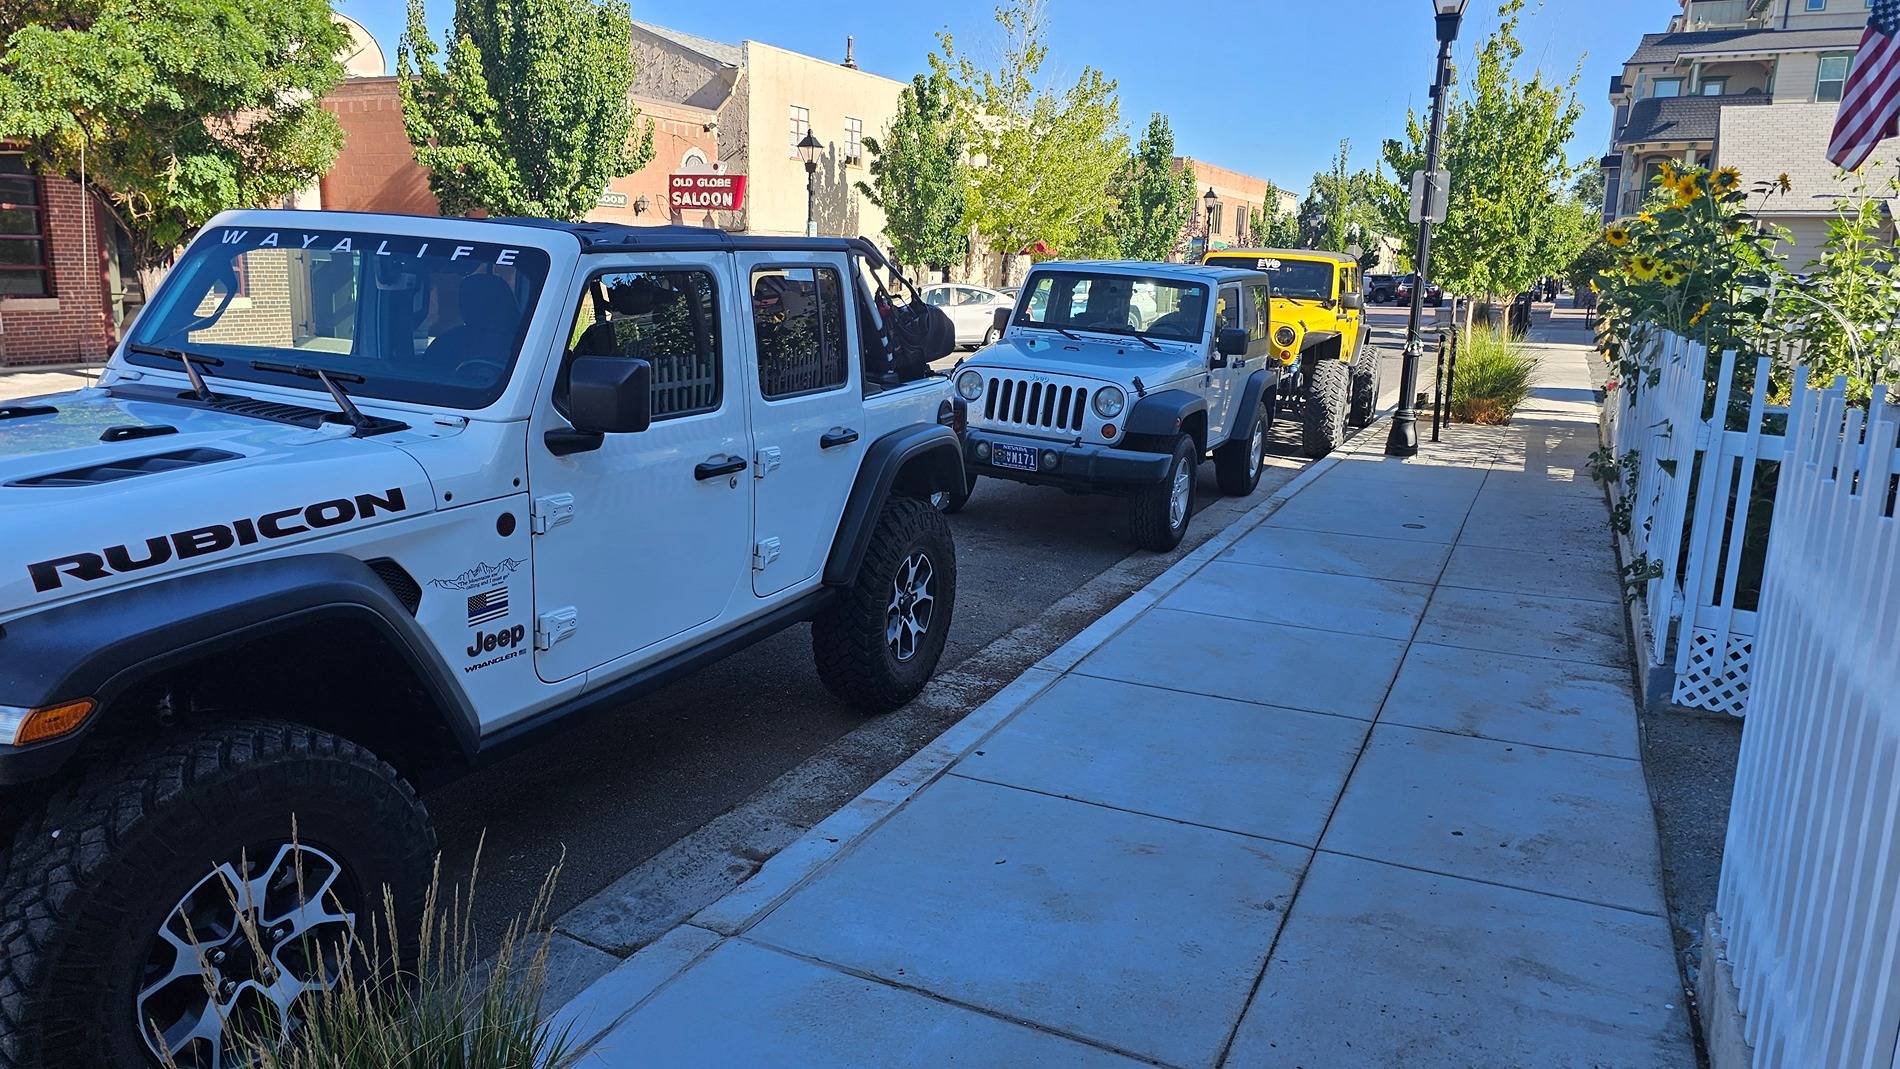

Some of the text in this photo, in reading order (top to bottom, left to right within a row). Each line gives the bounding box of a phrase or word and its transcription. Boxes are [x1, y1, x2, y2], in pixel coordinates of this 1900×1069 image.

[672, 178, 732, 188] OLD GLOBE
[671, 191, 733, 207] SALOON
[1003, 444, 1028, 453] NEVADA
[26, 487, 407, 593] RUBICON
[467, 623, 525, 658] Jeep
[464, 650, 518, 674] WRANGLER
